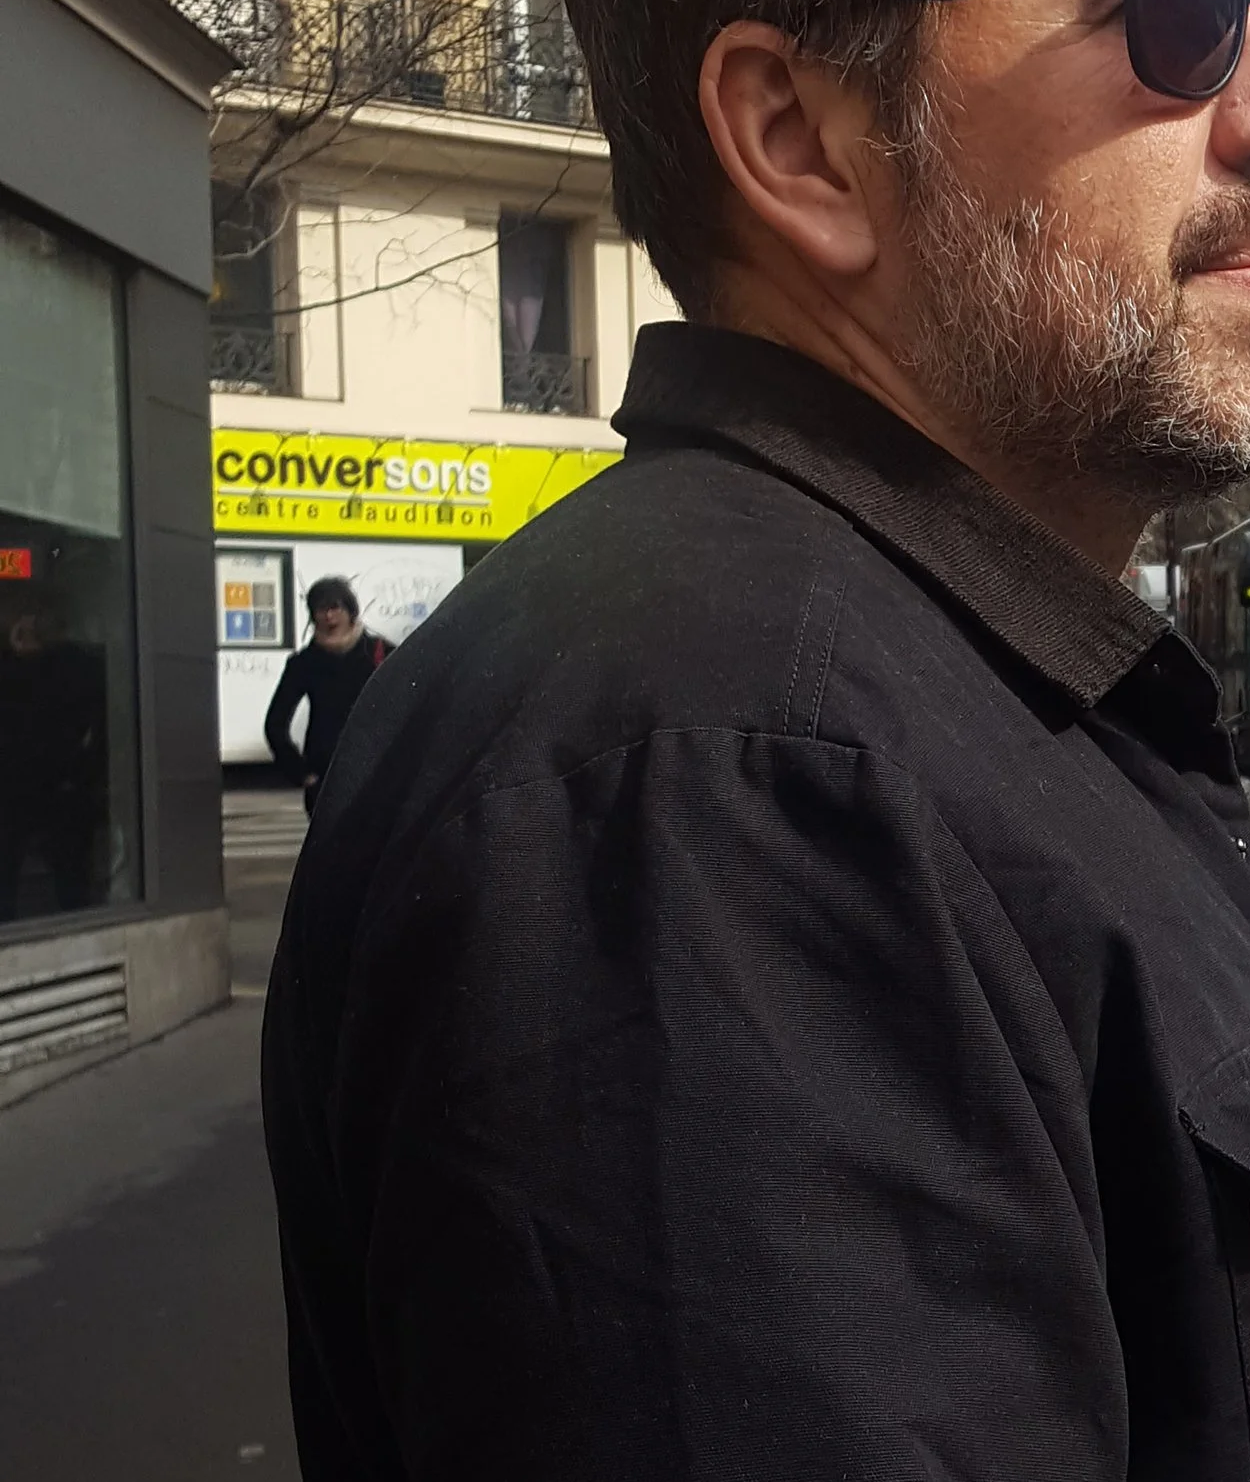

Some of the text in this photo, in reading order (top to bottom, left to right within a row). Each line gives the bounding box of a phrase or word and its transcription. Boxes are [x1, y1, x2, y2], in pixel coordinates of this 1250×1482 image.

[216, 449, 492, 495] conversons
[216, 495, 493, 527] centre d'audition
